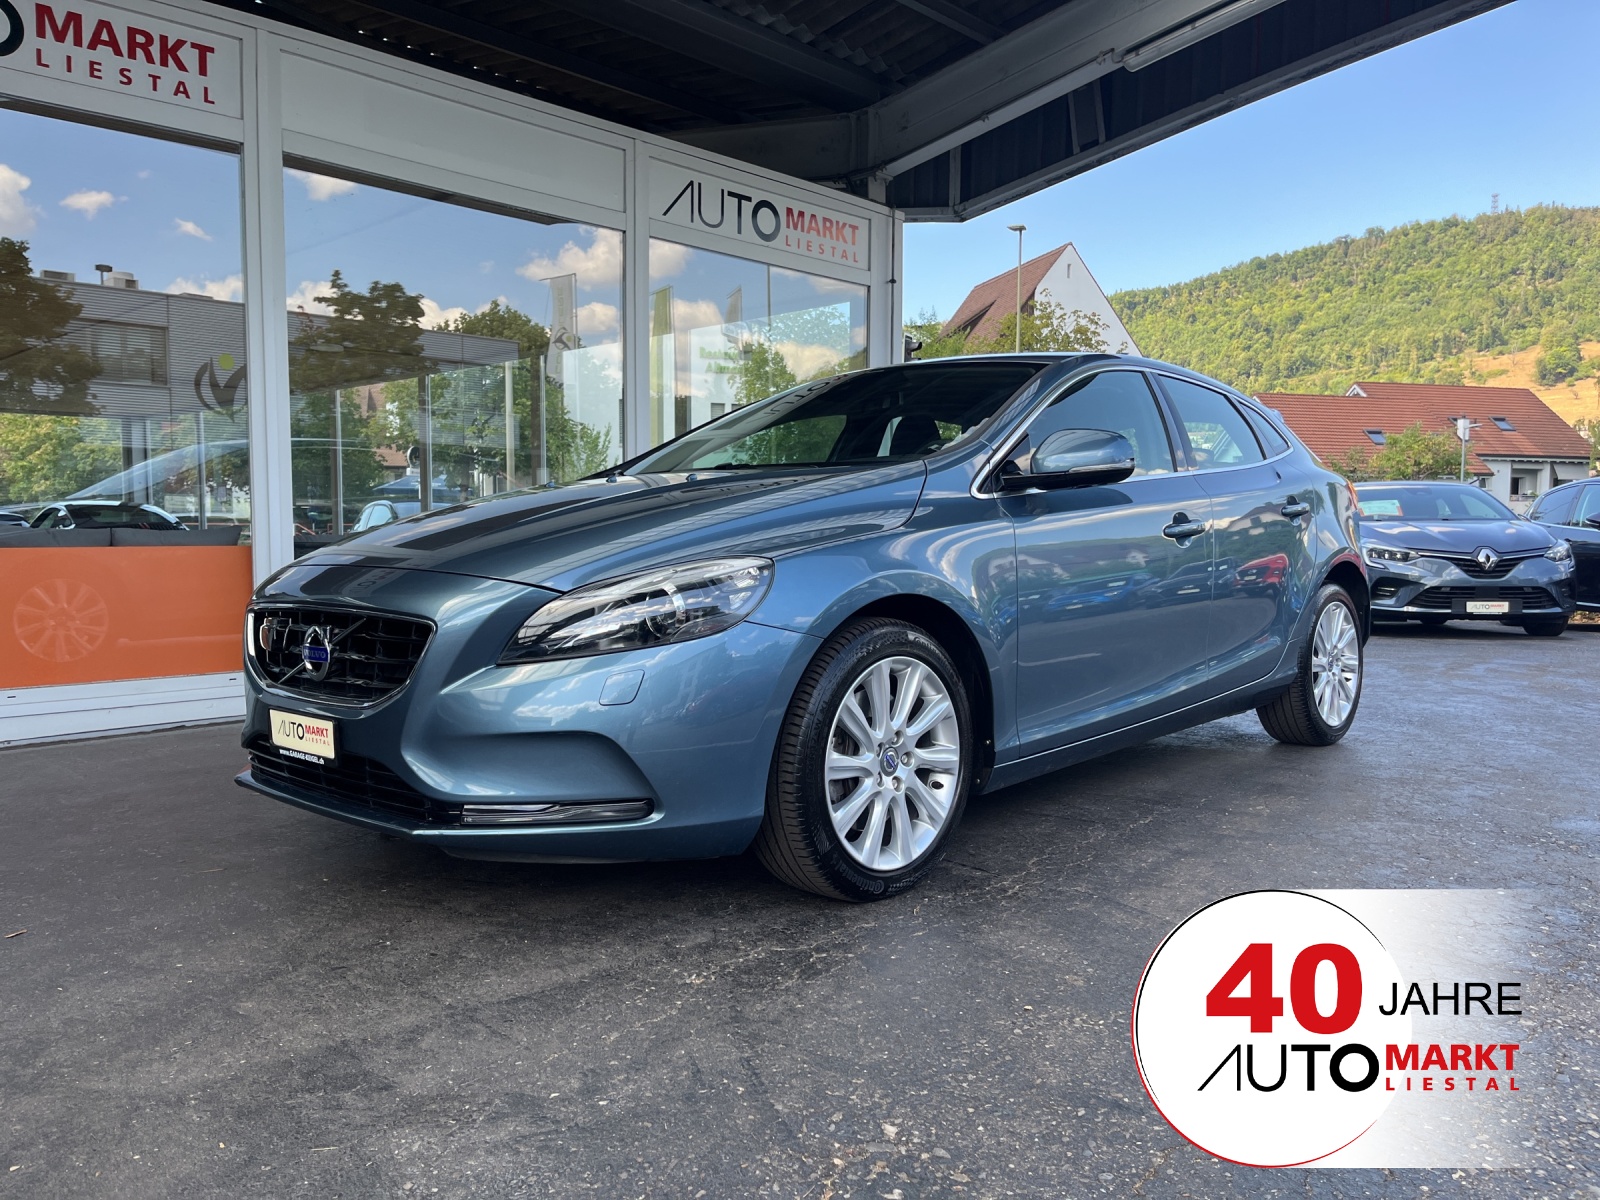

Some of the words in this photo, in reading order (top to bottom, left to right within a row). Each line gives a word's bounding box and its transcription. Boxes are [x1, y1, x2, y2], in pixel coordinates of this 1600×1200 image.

[35, 2, 215, 77] MARKT
[36, 48, 215, 105] LIESTAL
[662, 180, 781, 242] AUTO
[785, 206, 859, 246] MARKT
[785, 235, 859, 263] LIESTAL
[277, 720, 305, 740] AUTO
[305, 724, 329, 738] MARKT
[305, 736, 331, 746] LIESTAL
